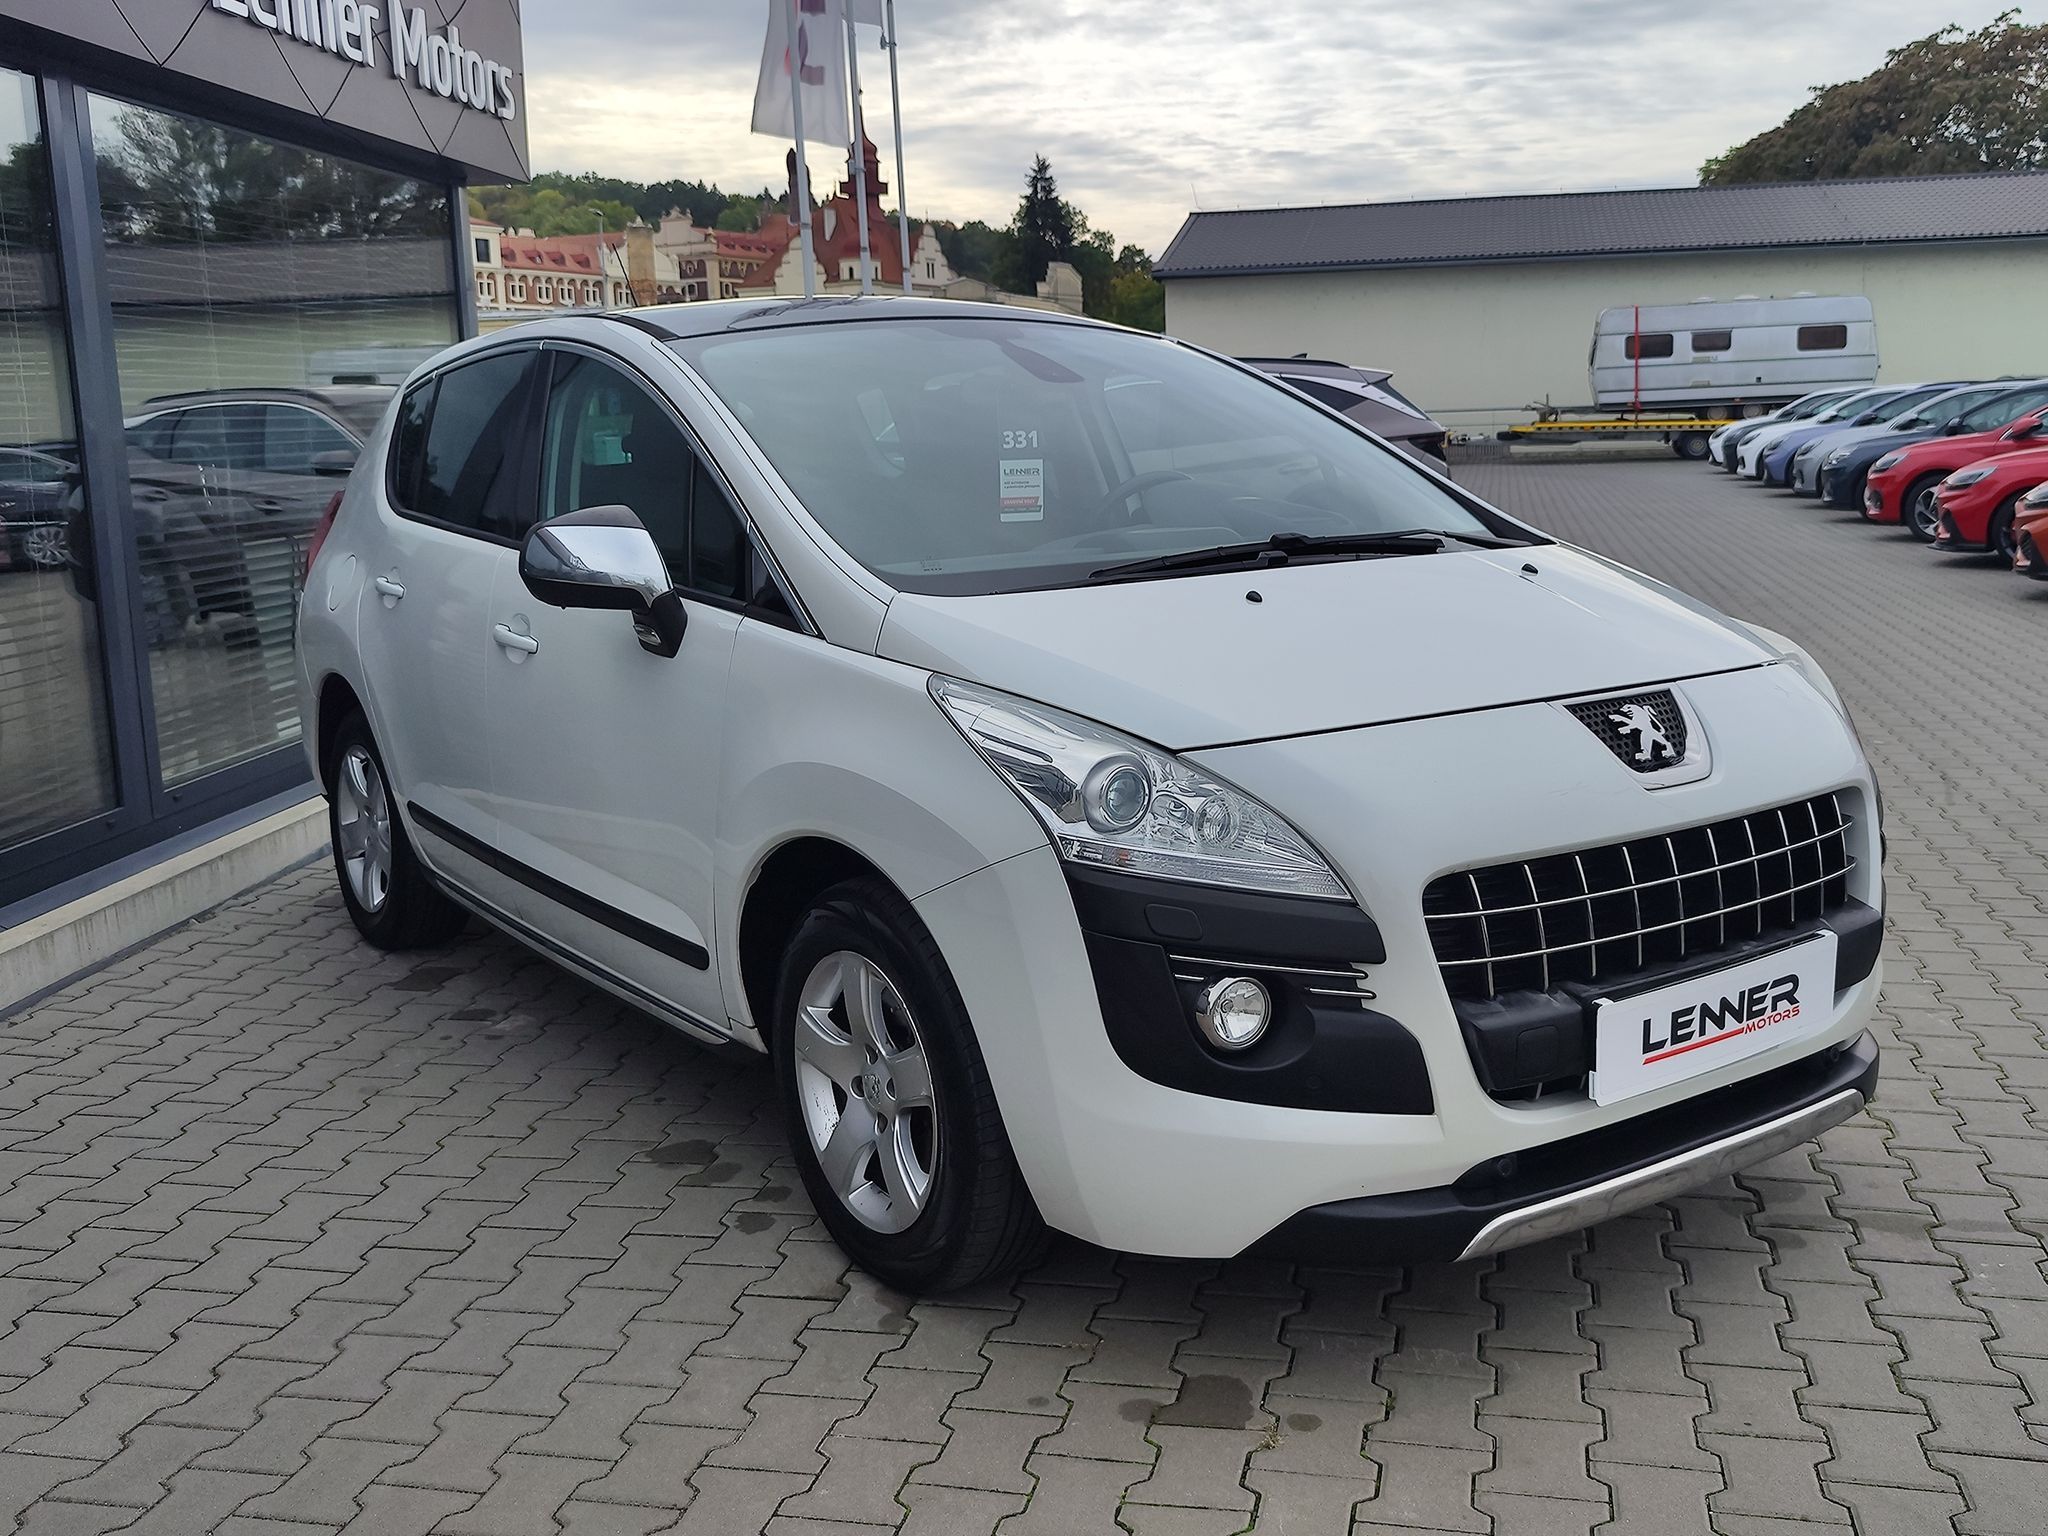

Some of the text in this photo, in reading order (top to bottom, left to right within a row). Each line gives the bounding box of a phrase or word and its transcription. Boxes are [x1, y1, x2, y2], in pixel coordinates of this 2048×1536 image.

[212, 0, 516, 121] nner Motors
[1003, 430, 1038, 449] 331
[1003, 467, 1040, 476] LENNER
[1642, 973, 1800, 1055] LENNER
[1743, 1004, 1801, 1035] MOTORS
